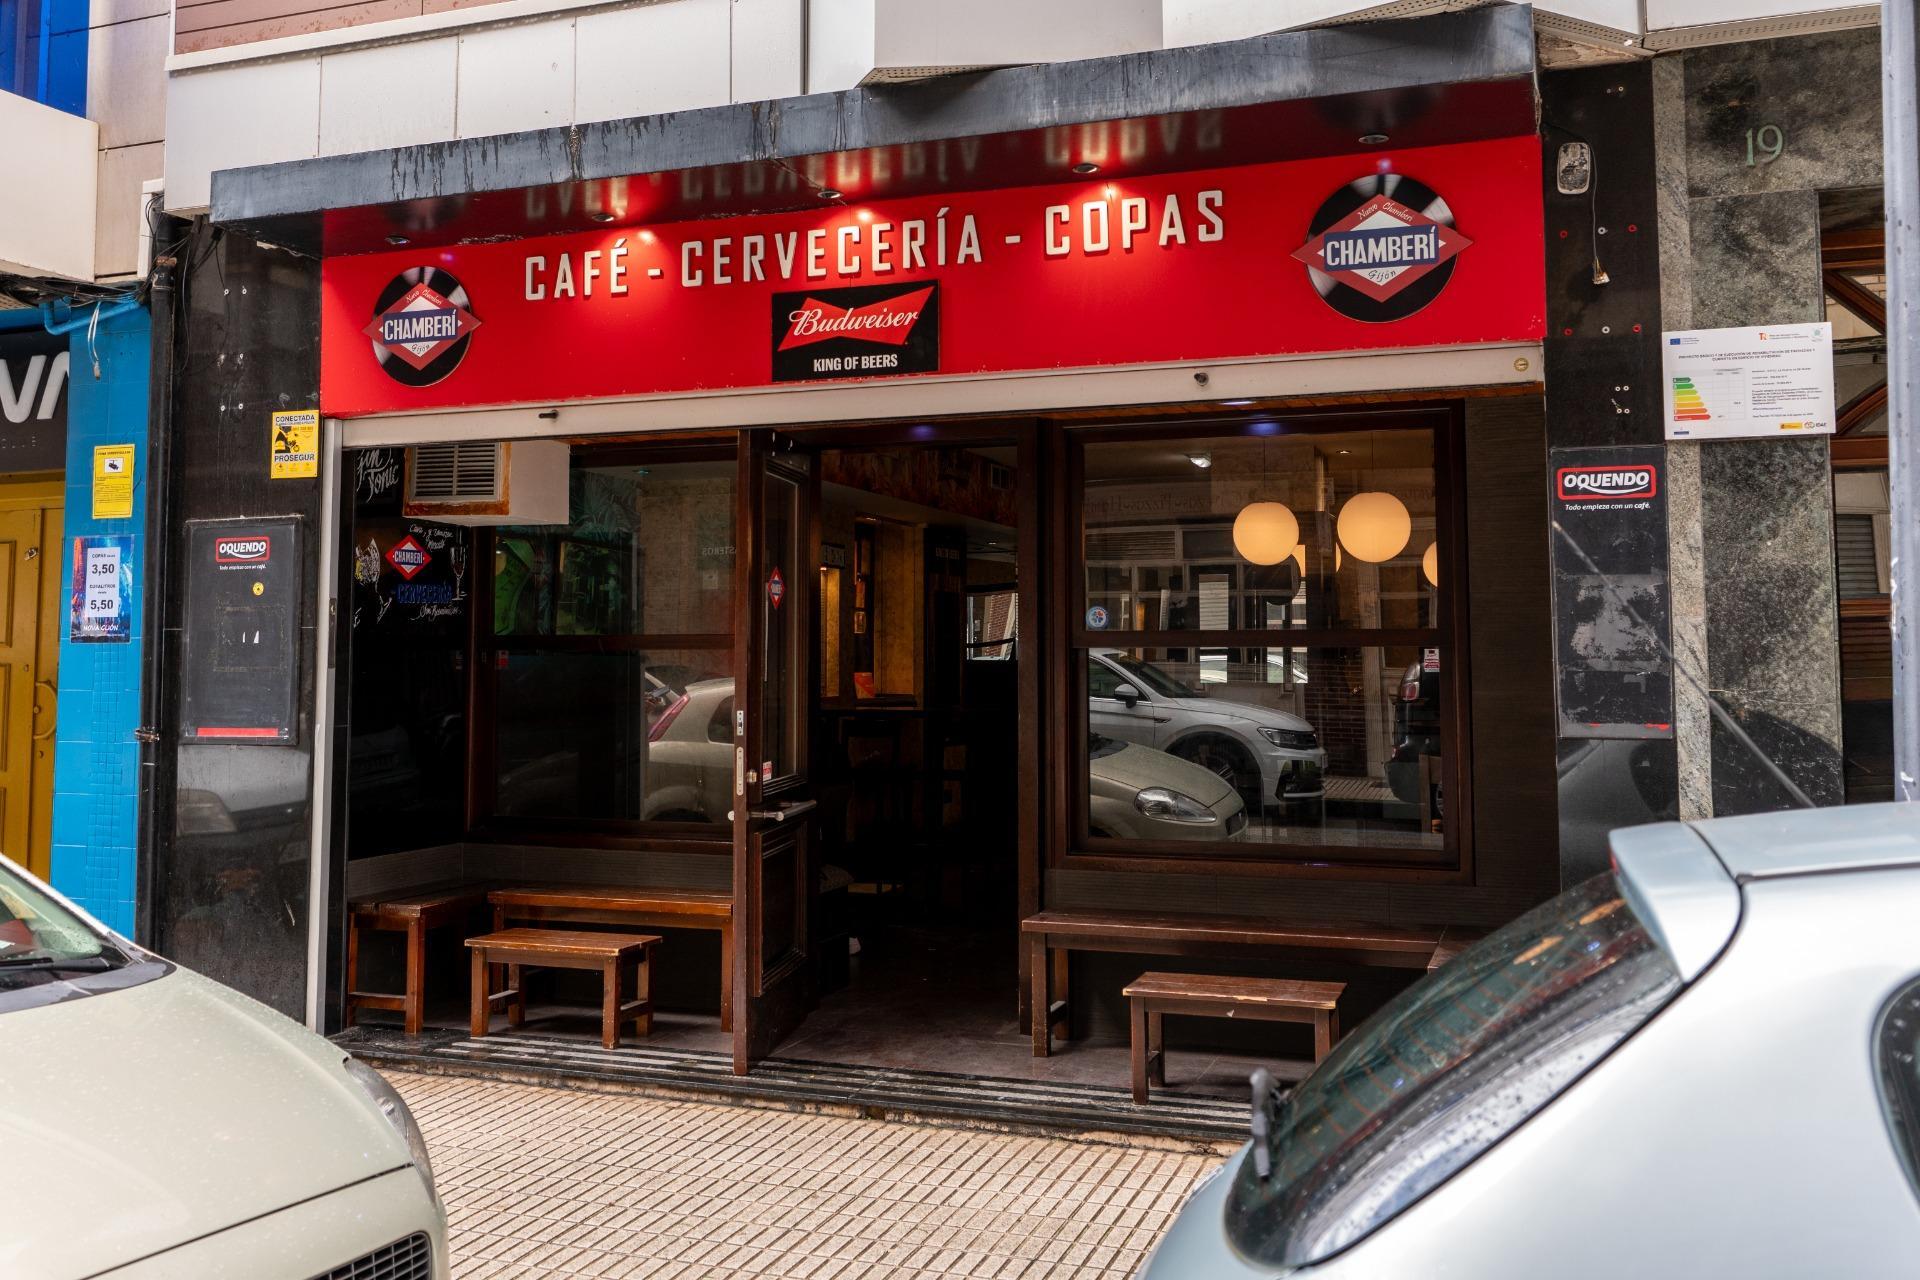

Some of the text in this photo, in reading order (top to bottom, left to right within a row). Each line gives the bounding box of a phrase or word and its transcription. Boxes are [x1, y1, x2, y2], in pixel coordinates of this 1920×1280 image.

[1745, 124, 1783, 167] 19
[1357, 203, 1378, 221] Nuevo
[525, 238, 628, 301] CAFÉ
[682, 207, 982, 288] CERVECERÍA
[1045, 190, 1224, 256] COPAS
[1327, 226, 1436, 266] CHAMBERÍ
[1368, 269, 1397, 283] Gijón
[384, 309, 456, 341] CHAMBERÍ
[789, 308, 919, 336] Budweiser
[813, 354, 898, 372] KING OF BEERS
[275, 414, 315, 423] CONECTADA
[274, 453, 315, 462] PROSEGUR
[1564, 472, 1650, 494] OQUENDO
[1582, 504, 1610, 512] empieza
[219, 541, 266, 558] OQUENDO
[92, 563, 115, 576] 3,50
[90, 599, 114, 612] 5,50
